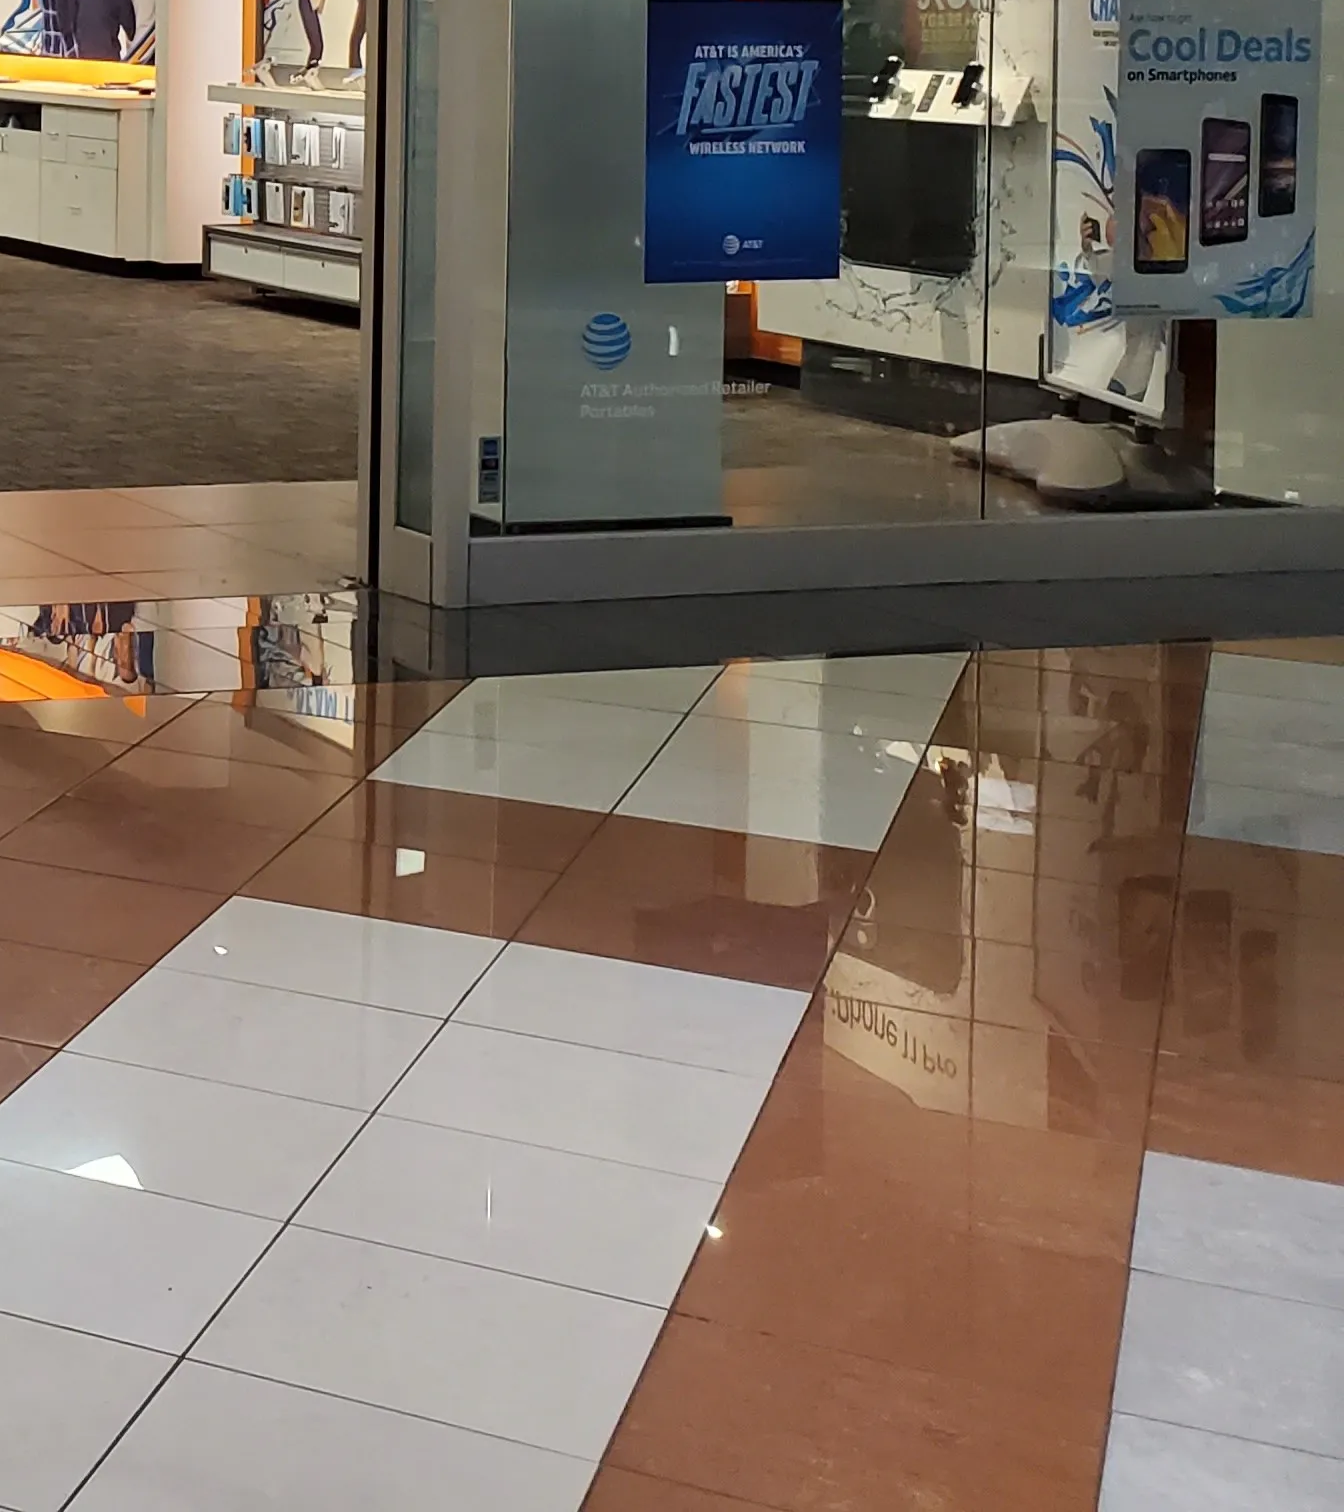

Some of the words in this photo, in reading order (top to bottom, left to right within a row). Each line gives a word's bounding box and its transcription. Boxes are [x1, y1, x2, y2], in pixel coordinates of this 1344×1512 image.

[694, 45, 725, 59] AT&T
[727, 45, 738, 58] IS
[741, 44, 805, 58] AMERICA'S
[1128, 27, 1207, 63] Cool
[1217, 27, 1311, 63] Deals
[1128, 70, 1145, 82] on
[1148, 68, 1237, 85] Smartphones
[676, 59, 819, 136] FASTEST
[689, 141, 746, 155] WIRELESS
[748, 140, 806, 154] NETWORK
[742, 240, 764, 250] AT&T
[580, 383, 619, 399] AT&T
[712, 378, 772, 395] Retailer
[580, 404, 656, 419] Portables
